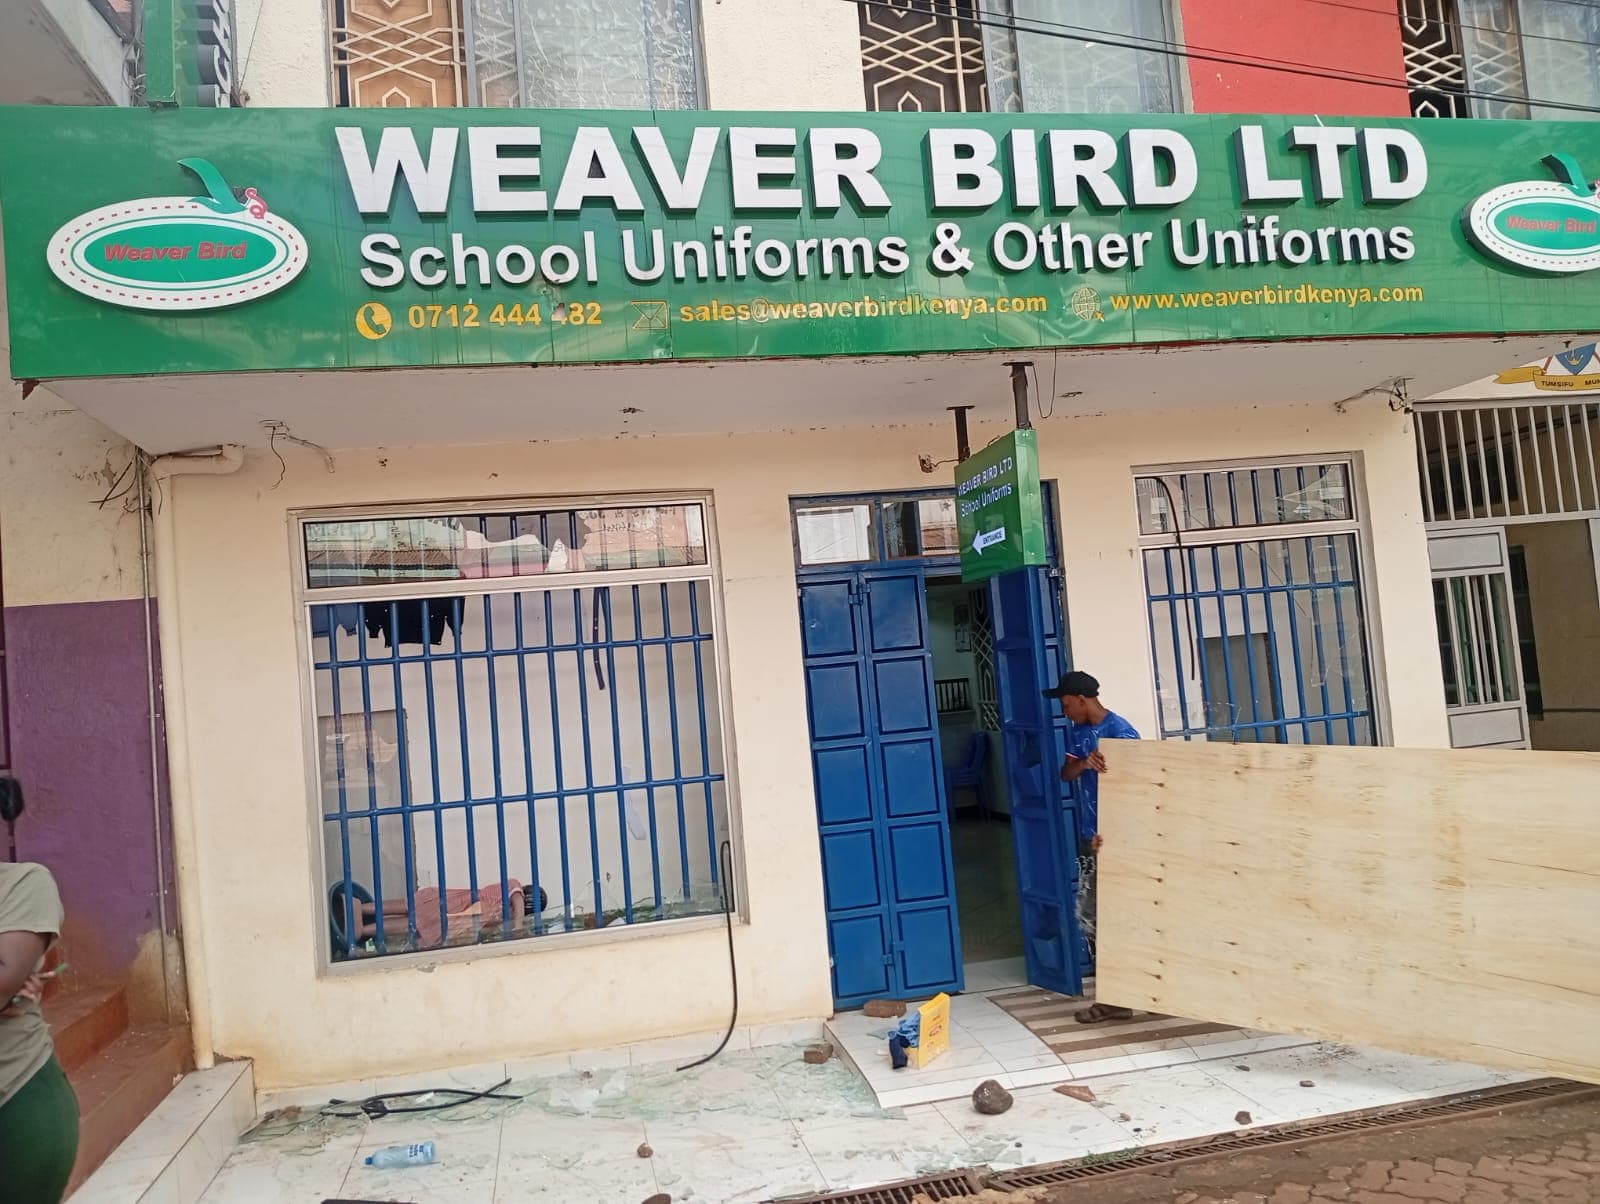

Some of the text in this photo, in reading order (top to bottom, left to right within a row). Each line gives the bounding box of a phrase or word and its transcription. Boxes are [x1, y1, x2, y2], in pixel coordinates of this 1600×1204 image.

[335, 125, 1429, 214] WEAVER BIRD LTD
[1507, 216, 1597, 232] Weaver Bird
[104, 240, 248, 262] Weaver Bird
[360, 215, 1415, 287] School Uniforms & Other Uniforms
[680, 293, 1048, 323] sales@weaverbirdkenya.com
[1110, 284, 1424, 309] www.weaverbirdkenya.com
[408, 302, 602, 329] 0712 444 482
[958, 456, 1013, 496] WEAVER BIRD LTD
[961, 483, 1012, 517] School Uniforms
